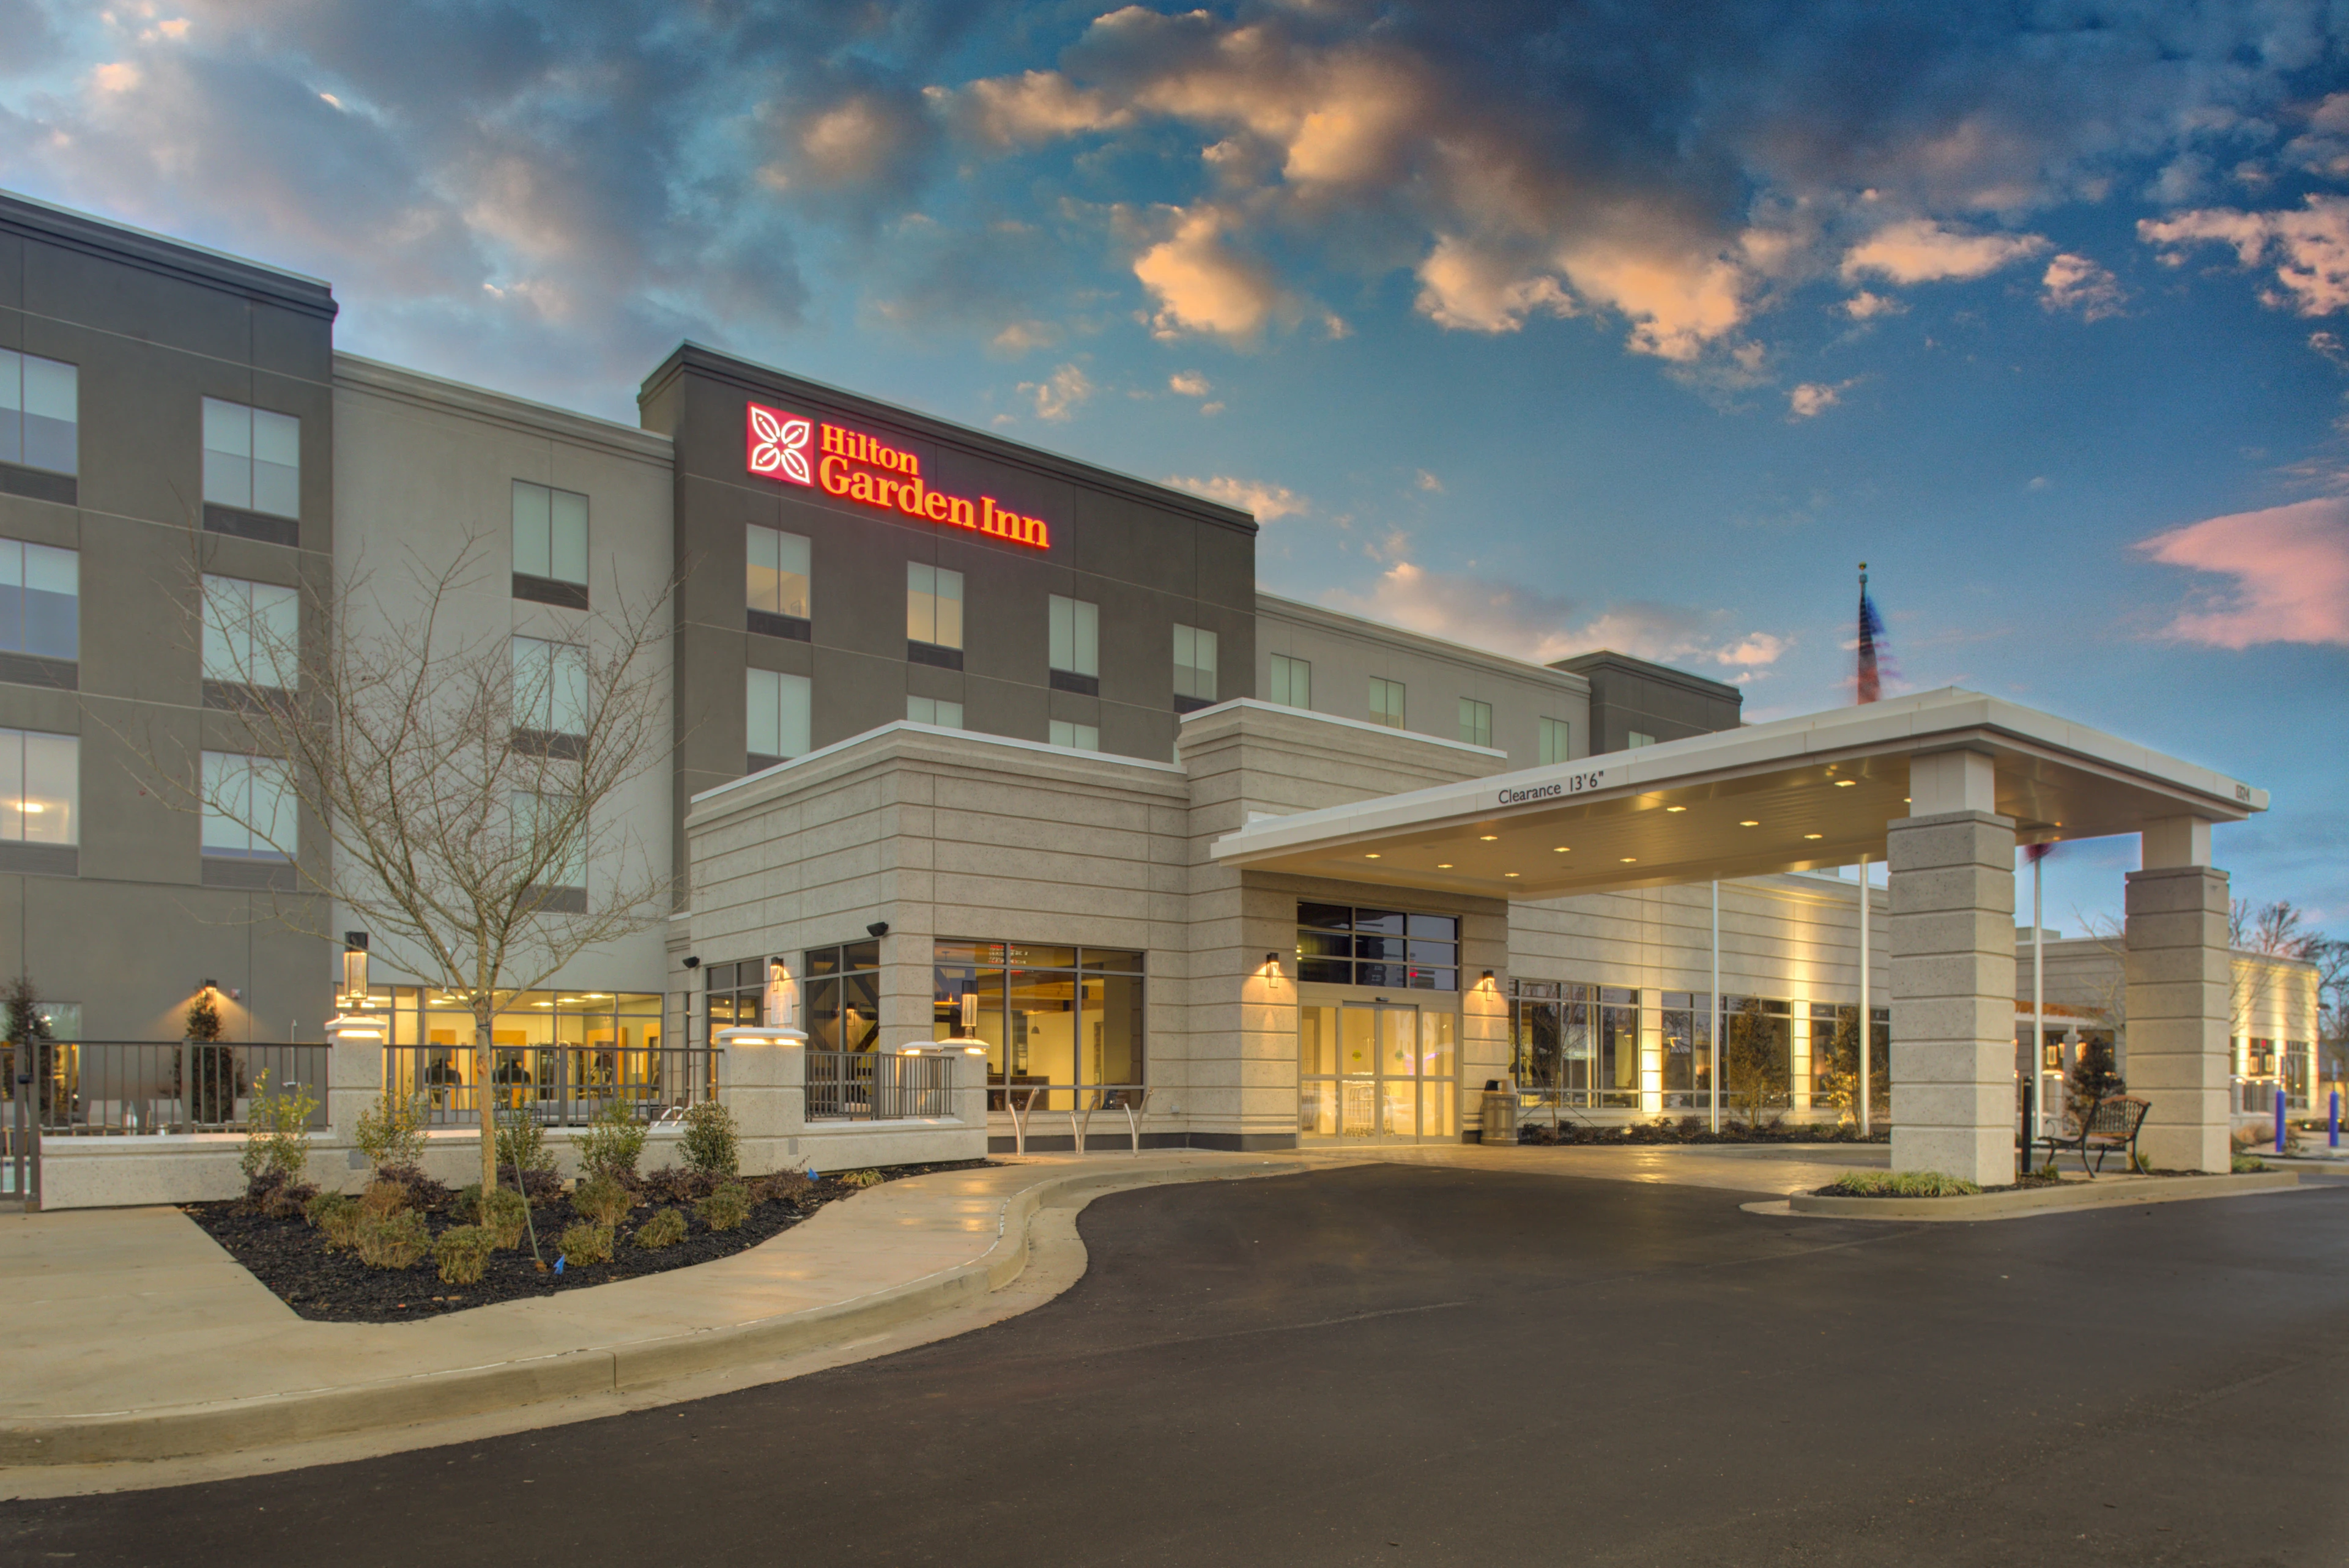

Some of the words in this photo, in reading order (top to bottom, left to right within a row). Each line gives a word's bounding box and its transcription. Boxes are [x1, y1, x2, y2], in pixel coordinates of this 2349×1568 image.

[820, 423, 919, 475] Hilton
[819, 455, 977, 530] Garden
[980, 496, 1050, 547] Inn
[1499, 784, 1561, 804] Clearance
